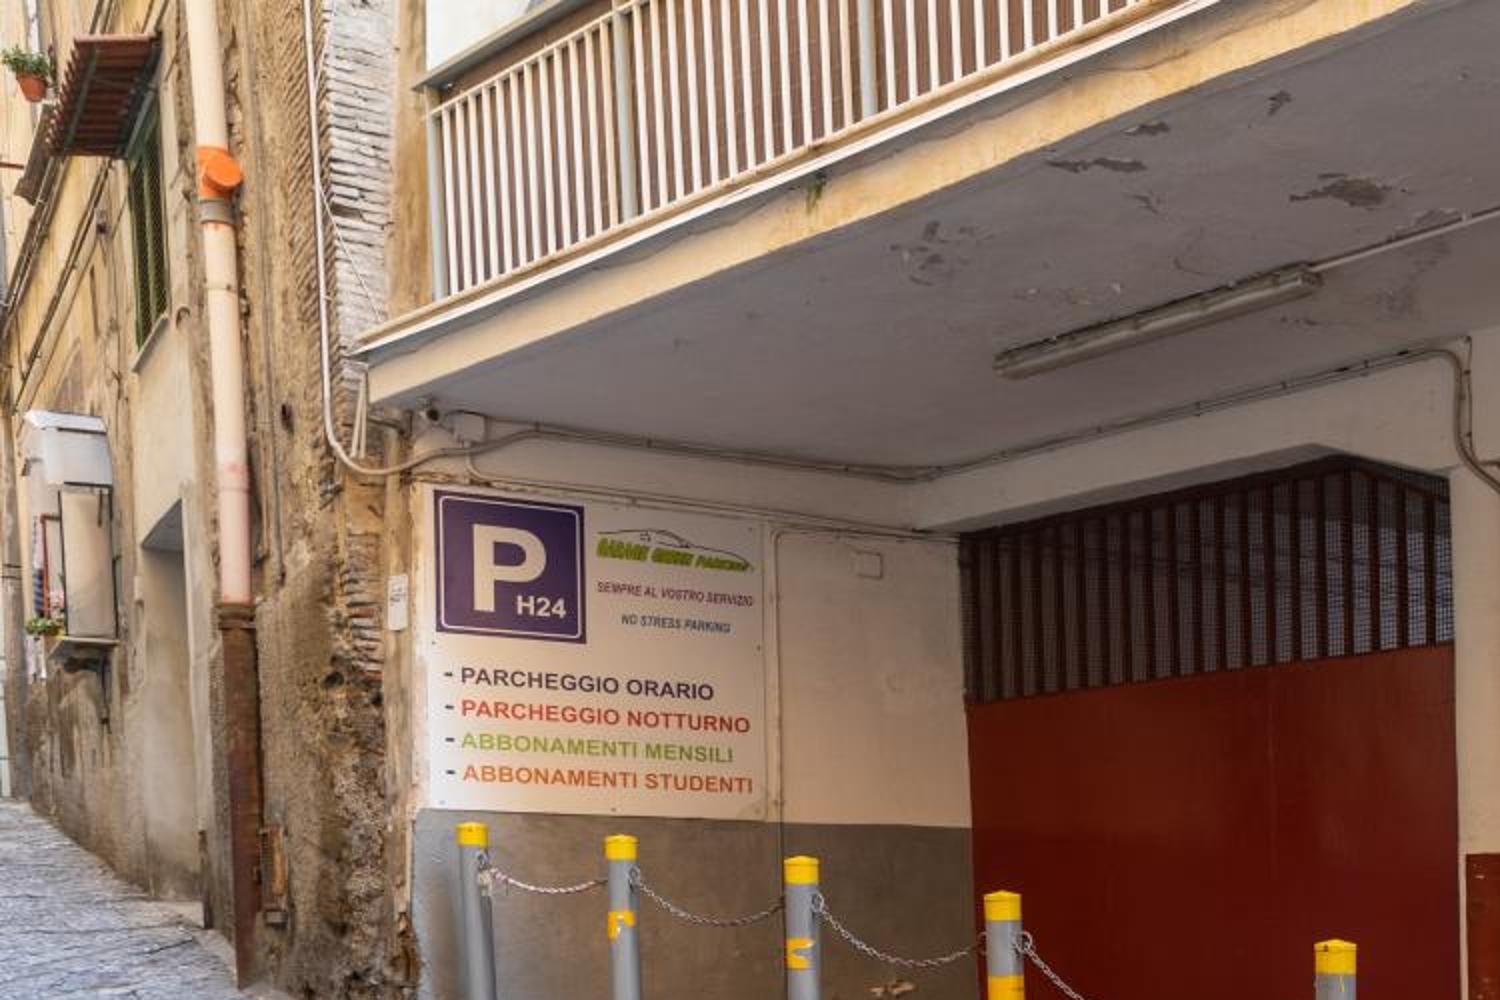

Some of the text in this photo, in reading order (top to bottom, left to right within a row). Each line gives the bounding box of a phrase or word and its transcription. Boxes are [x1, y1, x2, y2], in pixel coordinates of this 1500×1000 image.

[472, 522, 547, 613] P
[516, 595, 566, 619] H24
[597, 581, 754, 607] SEMPRE AL VOSTRO SERVIZIO
[621, 614, 731, 634] NO STRESS PARKING
[460, 666, 714, 701] PARCHEGGIO ORARIO
[461, 699, 750, 733] PARCHEGGIO NOTTURNO
[461, 732, 733, 764] ABBONAMENTI MENSILI
[462, 764, 753, 794] ABBONAMENTI STUDENTI
